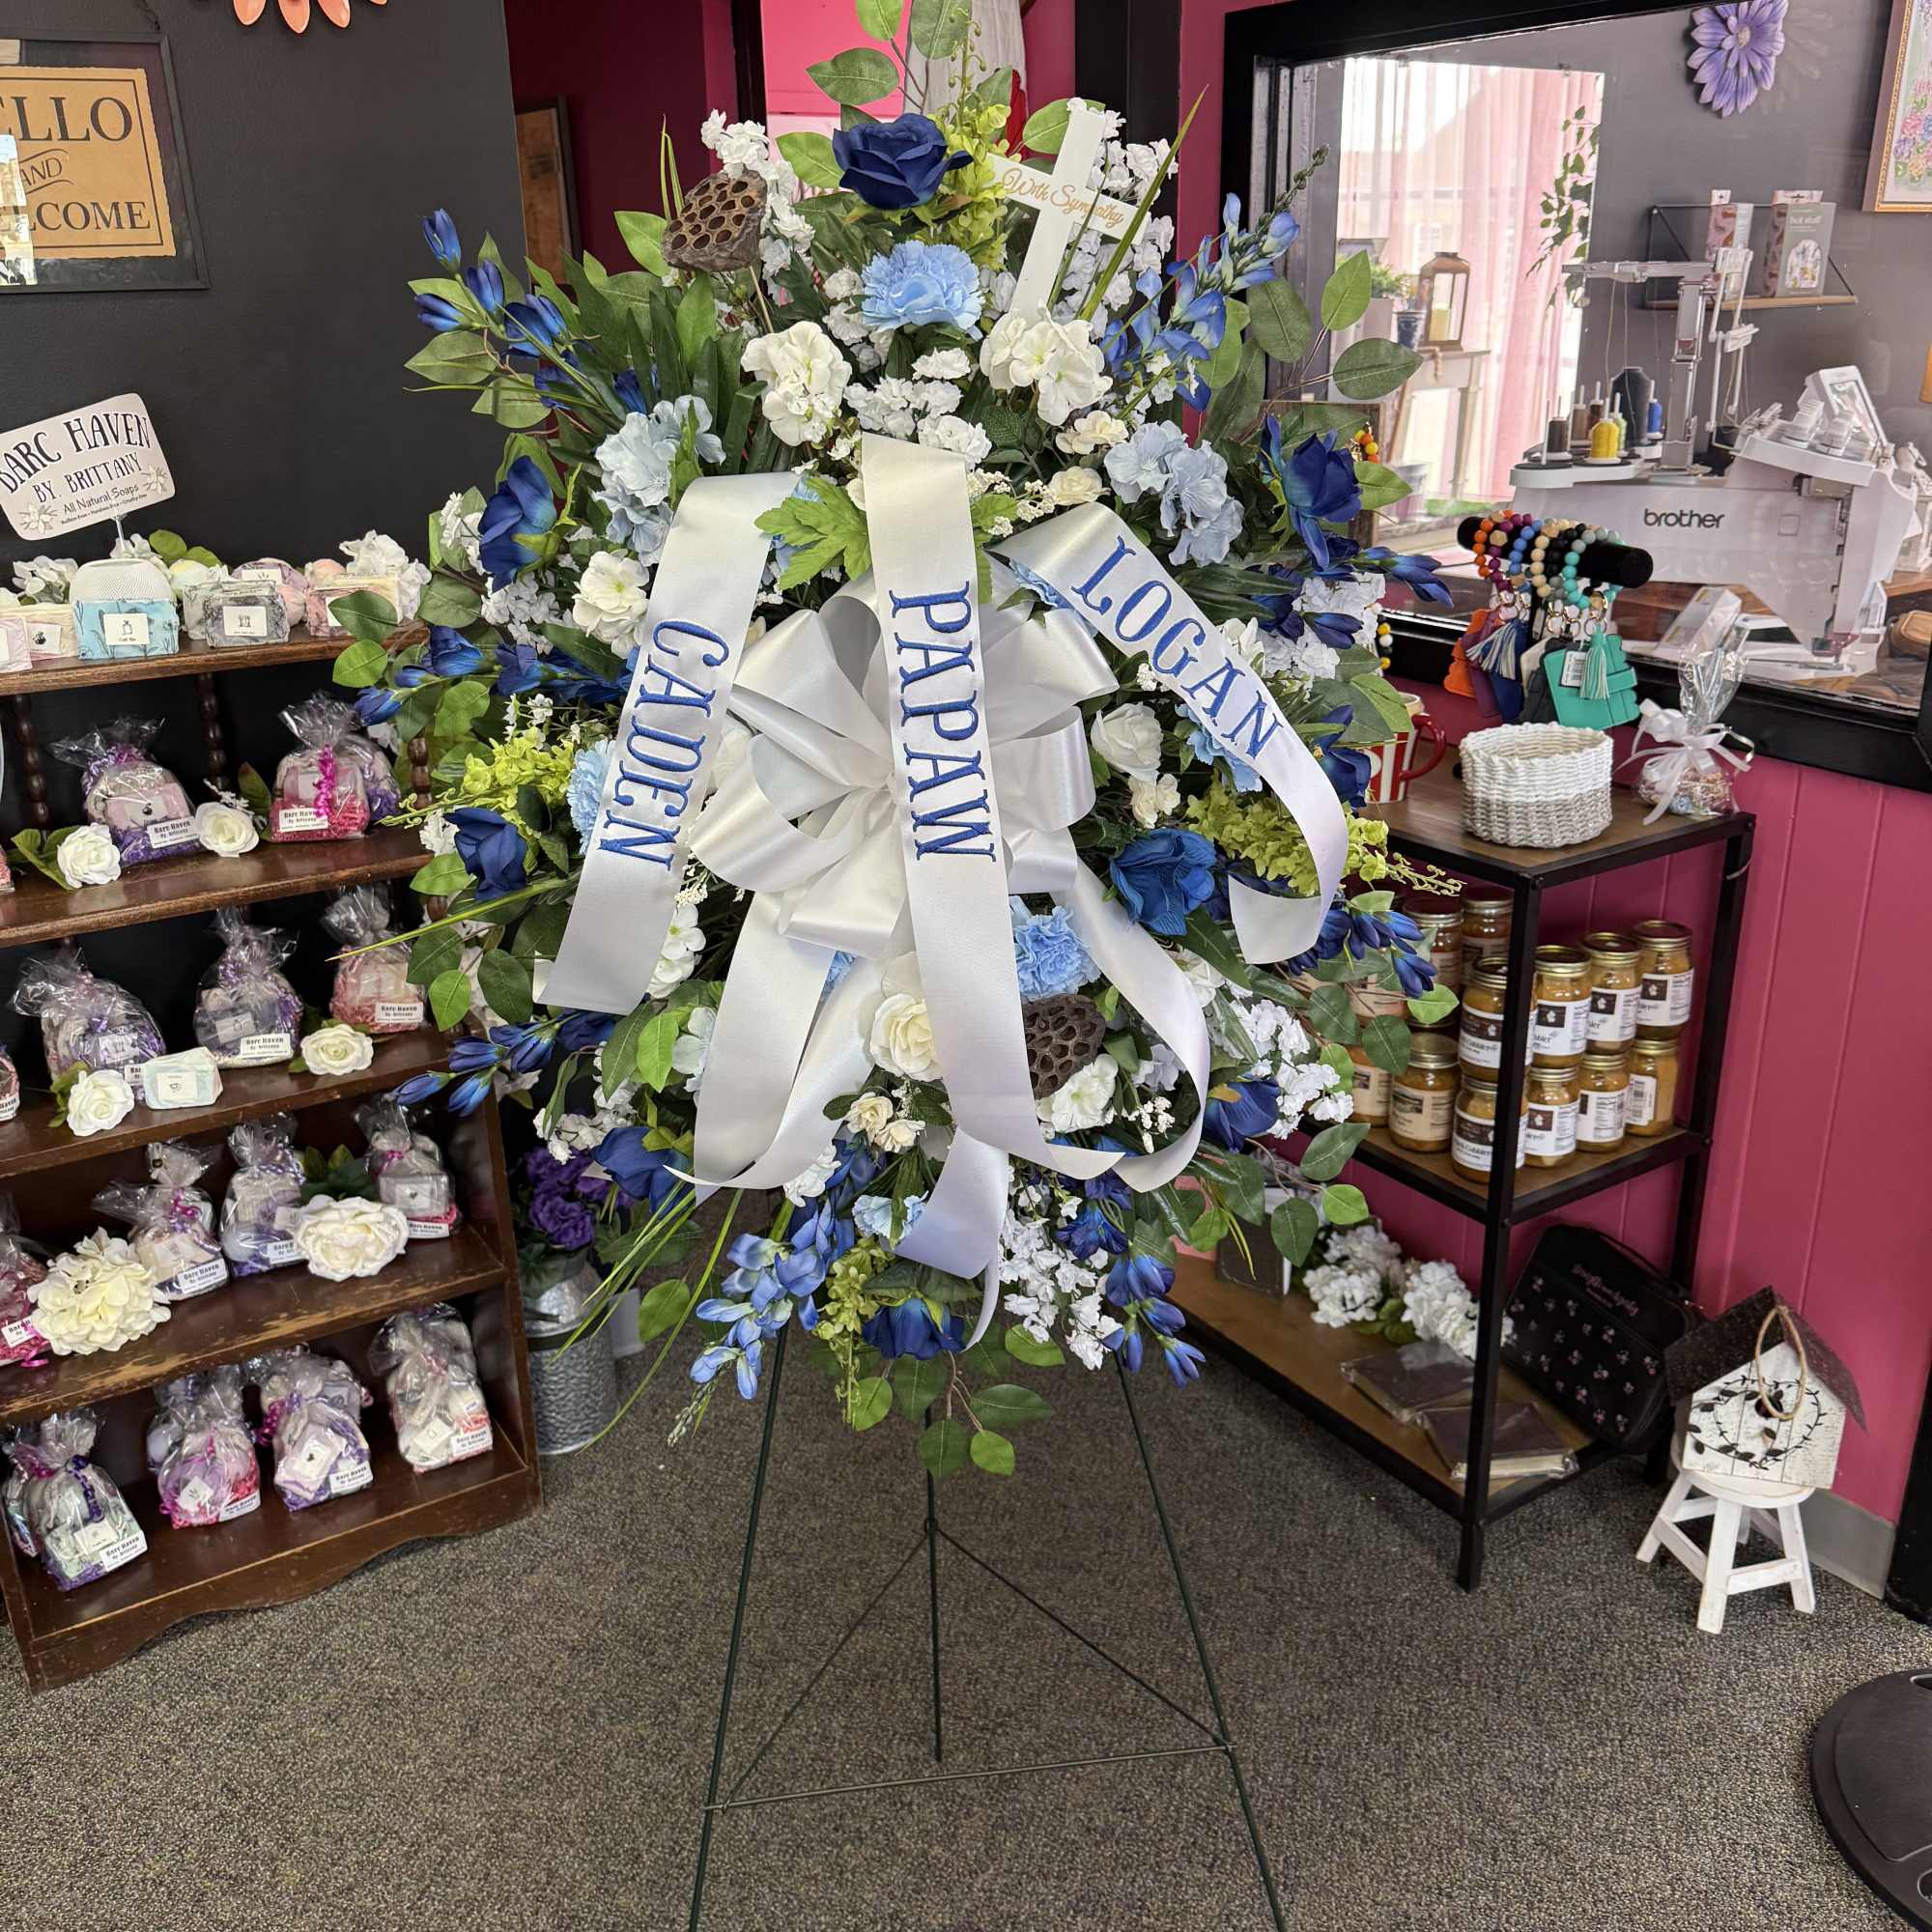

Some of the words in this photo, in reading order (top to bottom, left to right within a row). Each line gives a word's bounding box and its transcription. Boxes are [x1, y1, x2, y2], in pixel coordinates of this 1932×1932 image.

[0, 96, 133, 141] LLO
[0, 201, 151, 232] COME
[1002, 167, 1050, 201] With
[1050, 185, 1124, 229] Sympathy
[63, 412, 151, 453] HAVEN
[64, 451, 142, 494] BRITTANY
[63, 501, 76, 515] All
[76, 491, 112, 511] Natural
[111, 484, 139, 499] Soaps
[1643, 508, 1725, 529] brother
[1070, 535, 1284, 759] LOGAN
[888, 581, 996, 863] PAPAW
[596, 620, 730, 871] CADEN
